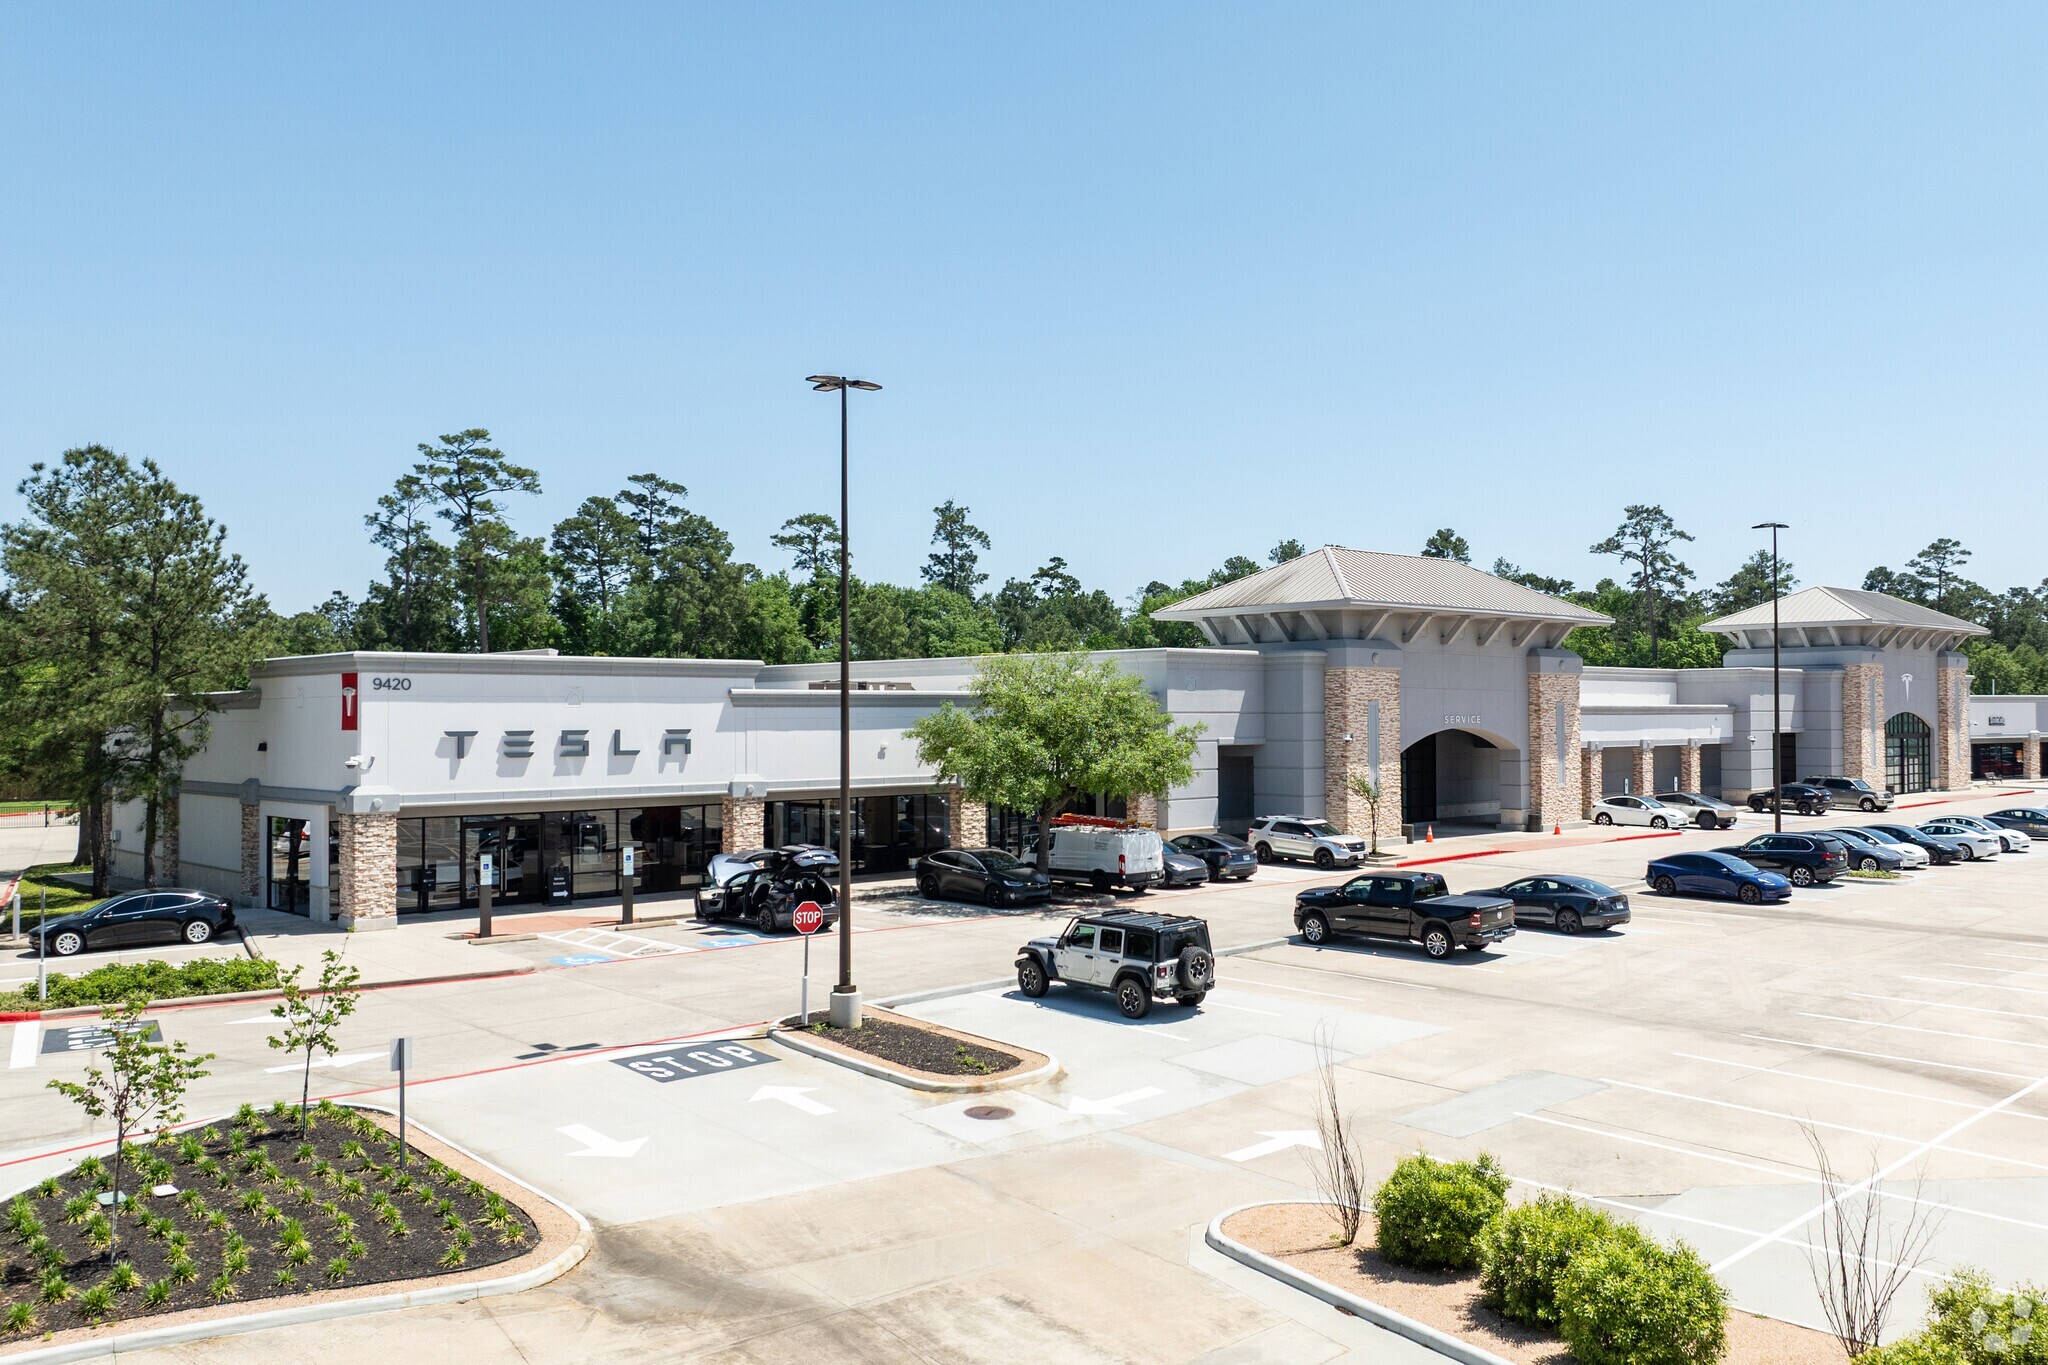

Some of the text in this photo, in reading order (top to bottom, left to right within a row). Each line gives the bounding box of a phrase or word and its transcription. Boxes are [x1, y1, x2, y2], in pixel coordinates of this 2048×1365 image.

[372, 677, 412, 691] 9420
[1444, 715, 1481, 724] SERVICE
[444, 728, 692, 760] TESLA
[795, 911, 821, 925] STOP
[628, 1045, 757, 1078] STOP
